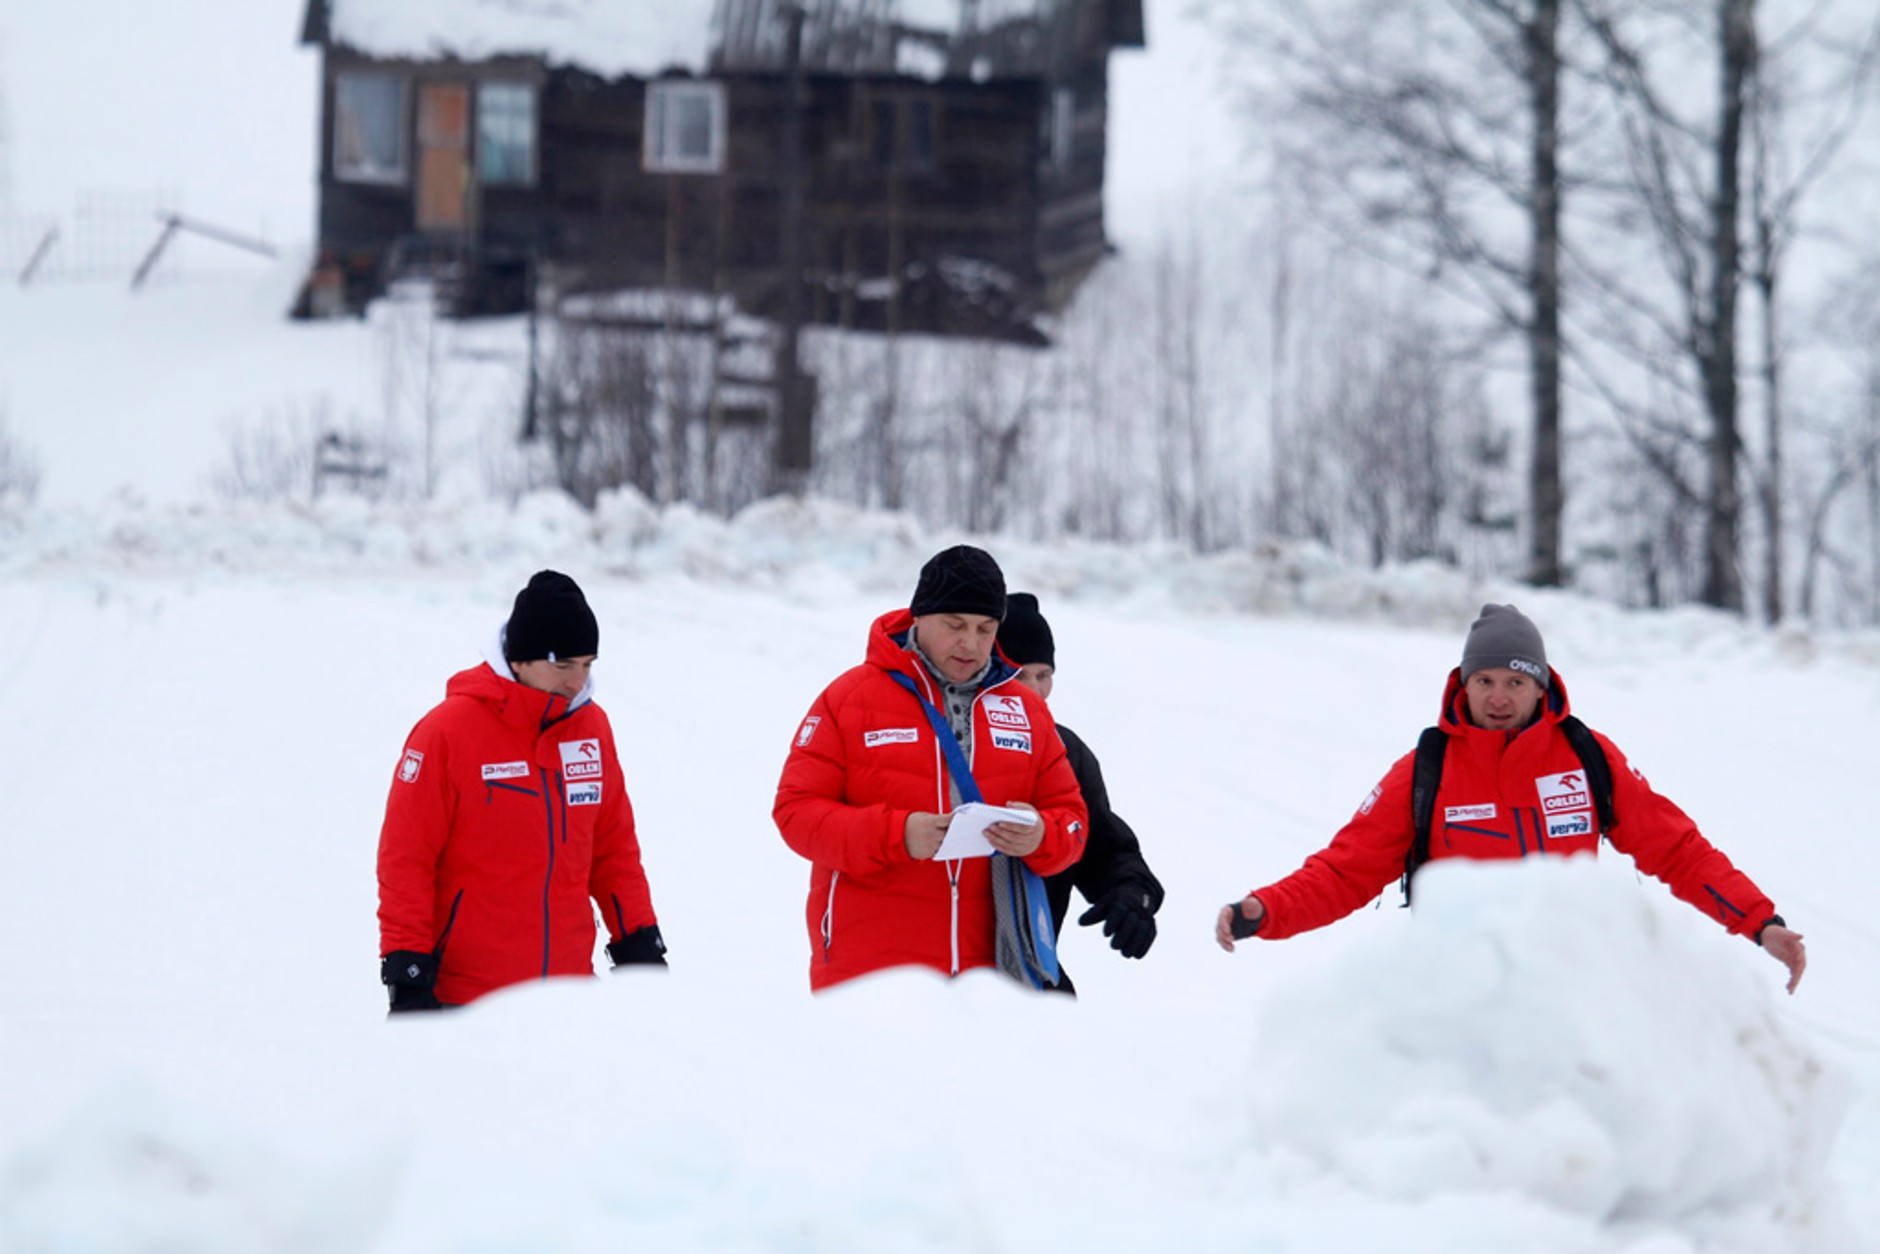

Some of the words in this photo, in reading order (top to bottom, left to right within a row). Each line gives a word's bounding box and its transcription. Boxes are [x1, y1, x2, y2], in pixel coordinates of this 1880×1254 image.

[990, 711, 1026, 725] ORLEN
[995, 736, 1030, 750] verva
[567, 762, 599, 775] ORLEN
[1546, 793, 1586, 809] ORLEN
[1550, 821, 1588, 835] verva
